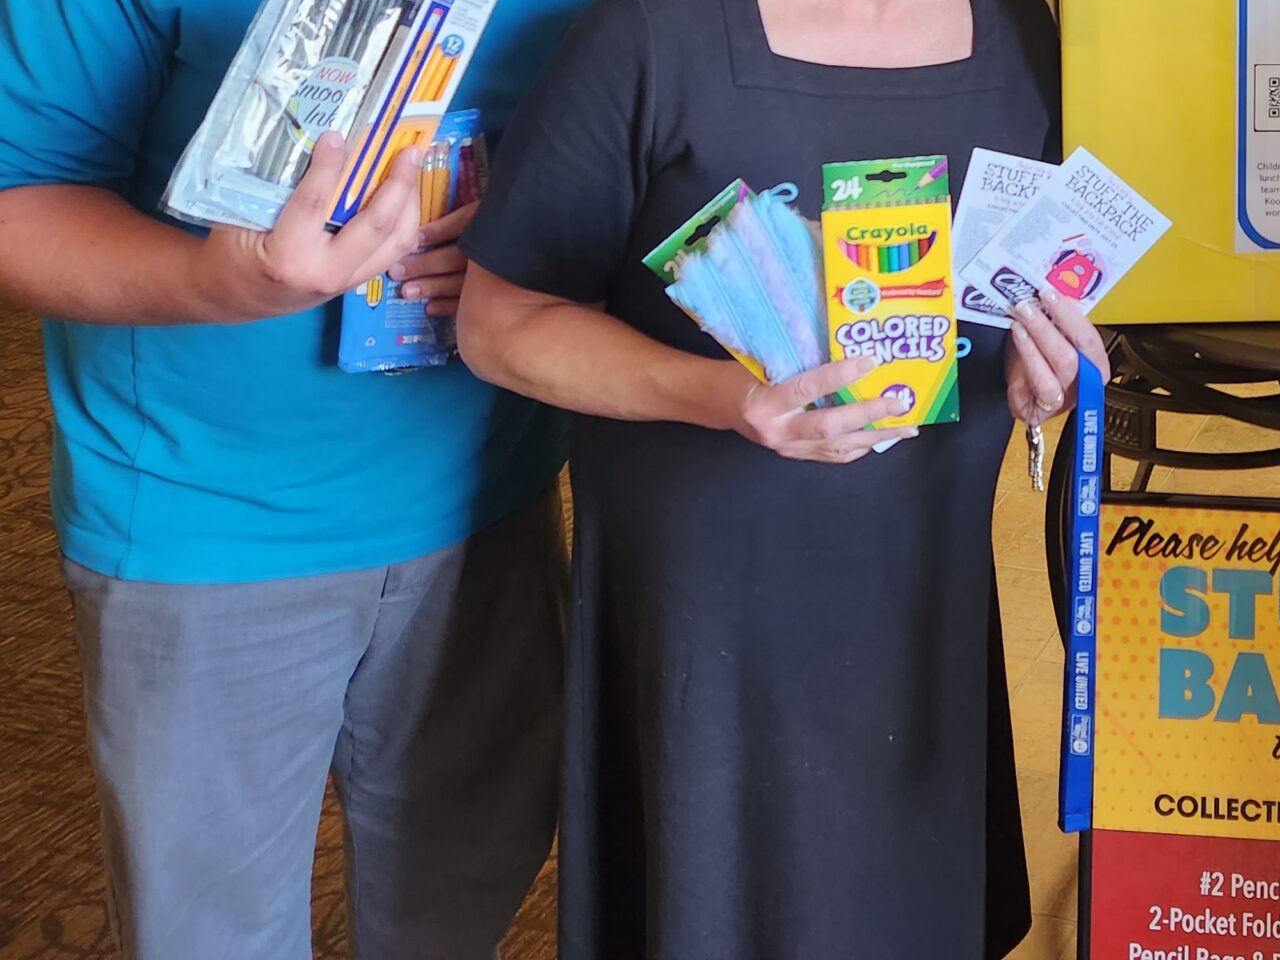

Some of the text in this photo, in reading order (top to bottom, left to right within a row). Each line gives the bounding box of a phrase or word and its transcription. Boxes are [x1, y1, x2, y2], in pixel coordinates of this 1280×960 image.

[315, 68, 357, 84] NOW
[831, 175, 863, 202] 24
[984, 162, 1044, 185] STUFF
[1065, 175, 1144, 242] BACKPACK
[1075, 165, 1124, 203] STUFF
[1121, 201, 1154, 232] THE
[846, 223, 928, 241] Crayola
[835, 315, 950, 347] COLORED
[843, 336, 946, 366] PENCILS
[1083, 409, 1098, 435] LIVE
[1082, 435, 1097, 473] UNITED
[1080, 531, 1094, 556] LIVE
[1105, 516, 1226, 561] Please
[1078, 557, 1093, 592] UNITED
[1075, 651, 1089, 675] LIVE
[1074, 675, 1088, 710] UNITED
[1200, 871, 1224, 897] #2
[1149, 906, 1236, 936] 2-Pocket
